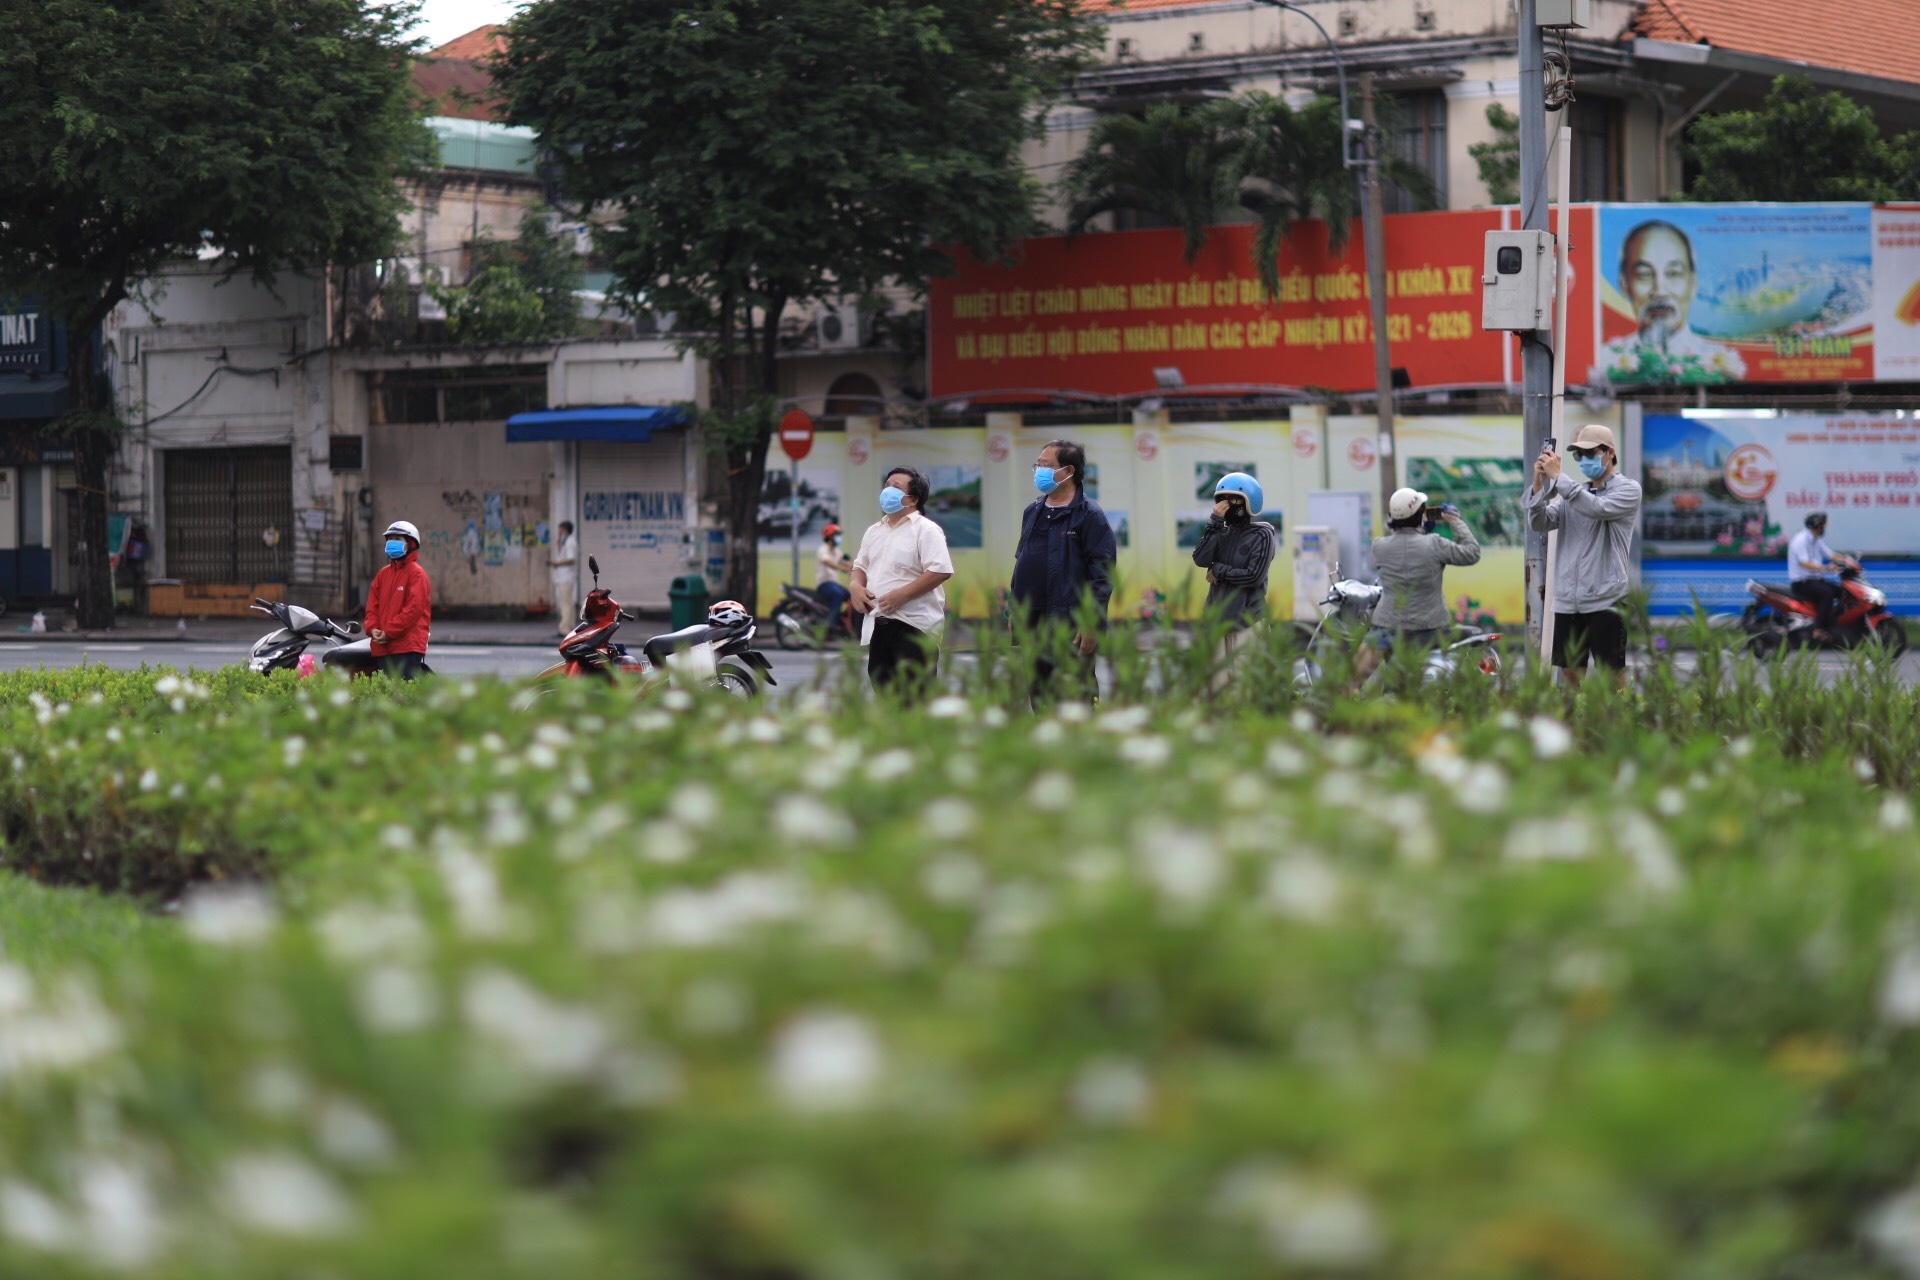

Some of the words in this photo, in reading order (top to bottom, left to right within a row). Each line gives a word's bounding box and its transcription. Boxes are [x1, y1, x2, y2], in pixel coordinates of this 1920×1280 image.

[954, 288, 997, 322] NHIỆT
[1000, 286, 1031, 320] LIỆT
[1034, 284, 1077, 315] CHÀO
[1080, 280, 1128, 312] MỪNG
[1131, 277, 1174, 309] NGÀY
[1177, 272, 1211, 307] BẦU
[1314, 263, 1361, 301] QUỐC
[1446, 266, 1474, 295] XV
[956, 331, 978, 359] VÀ
[1009, 323, 1044, 357] BIỂU
[1047, 325, 1075, 362] HỘI
[1123, 320, 1170, 352] NHÂN
[1172, 318, 1207, 350] DÂN
[1210, 316, 1245, 348] CÁC
[1247, 311, 1282, 347] CẤP
[1284, 313, 1342, 350] NHIỆM
[1428, 311, 1472, 340] 2026
[583, 491, 685, 520] GURUVIETNAM.VN
